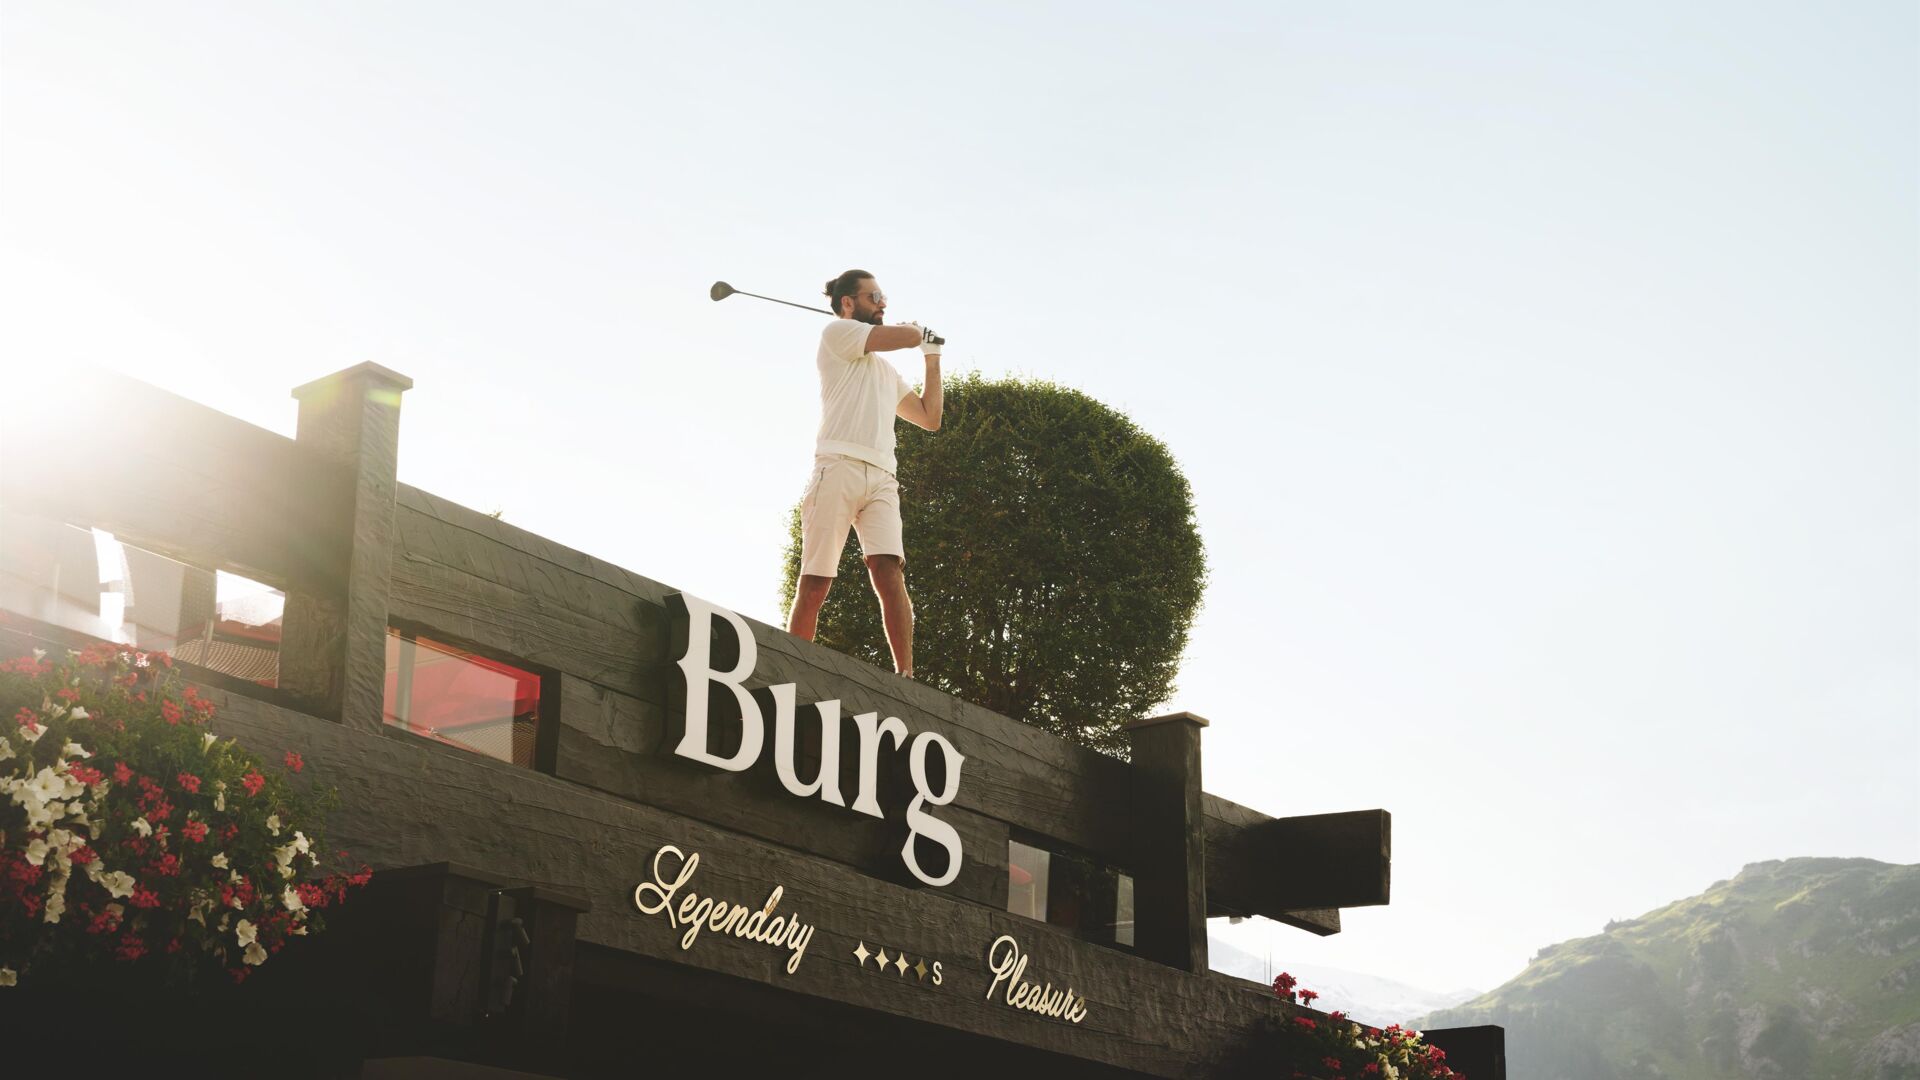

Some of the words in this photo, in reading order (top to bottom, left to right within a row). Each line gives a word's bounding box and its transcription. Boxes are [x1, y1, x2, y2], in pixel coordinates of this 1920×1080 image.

[674, 591, 965, 887] Burg
[635, 845, 815, 974] Legendary
[986, 935, 1087, 1023] Pleasure
